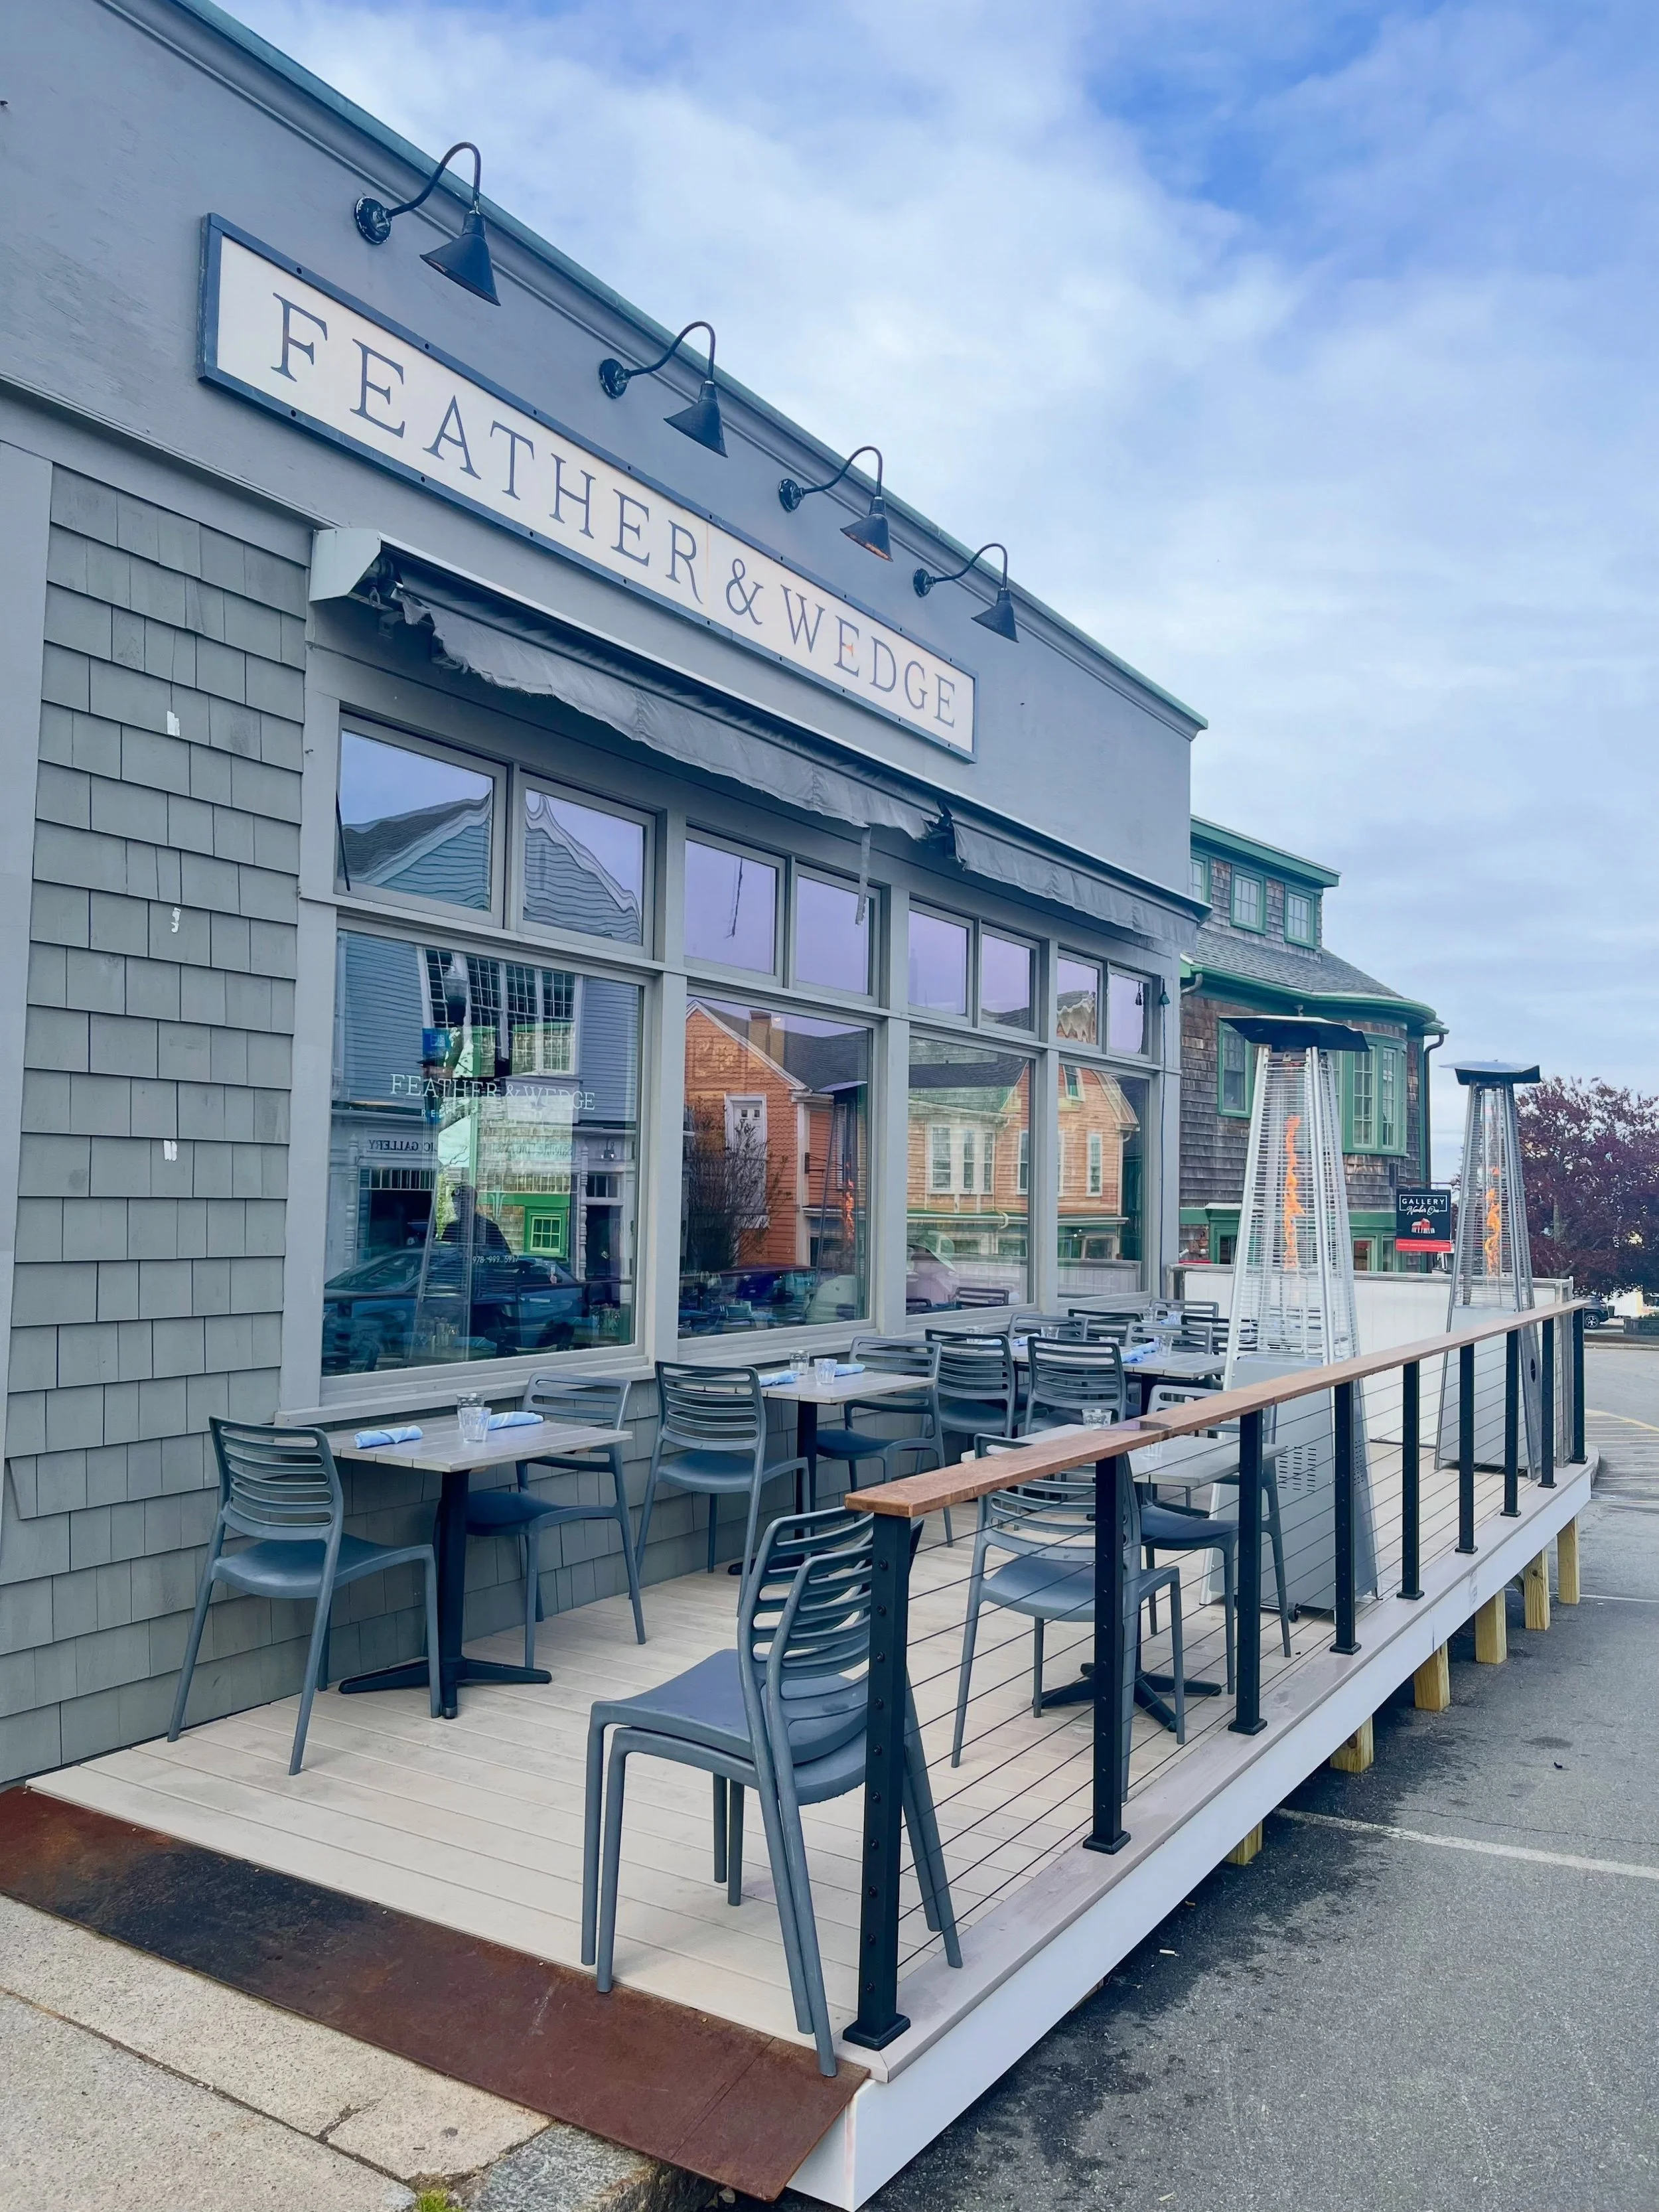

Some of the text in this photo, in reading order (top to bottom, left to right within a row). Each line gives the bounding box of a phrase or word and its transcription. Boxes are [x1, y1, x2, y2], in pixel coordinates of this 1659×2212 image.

[271, 293, 956, 729] FEATHER & WEDGE
[390, 1073, 498, 1101] FEATHER
[506, 1084, 520, 1100] &
[1406, 1205, 1440, 1215] Number One
